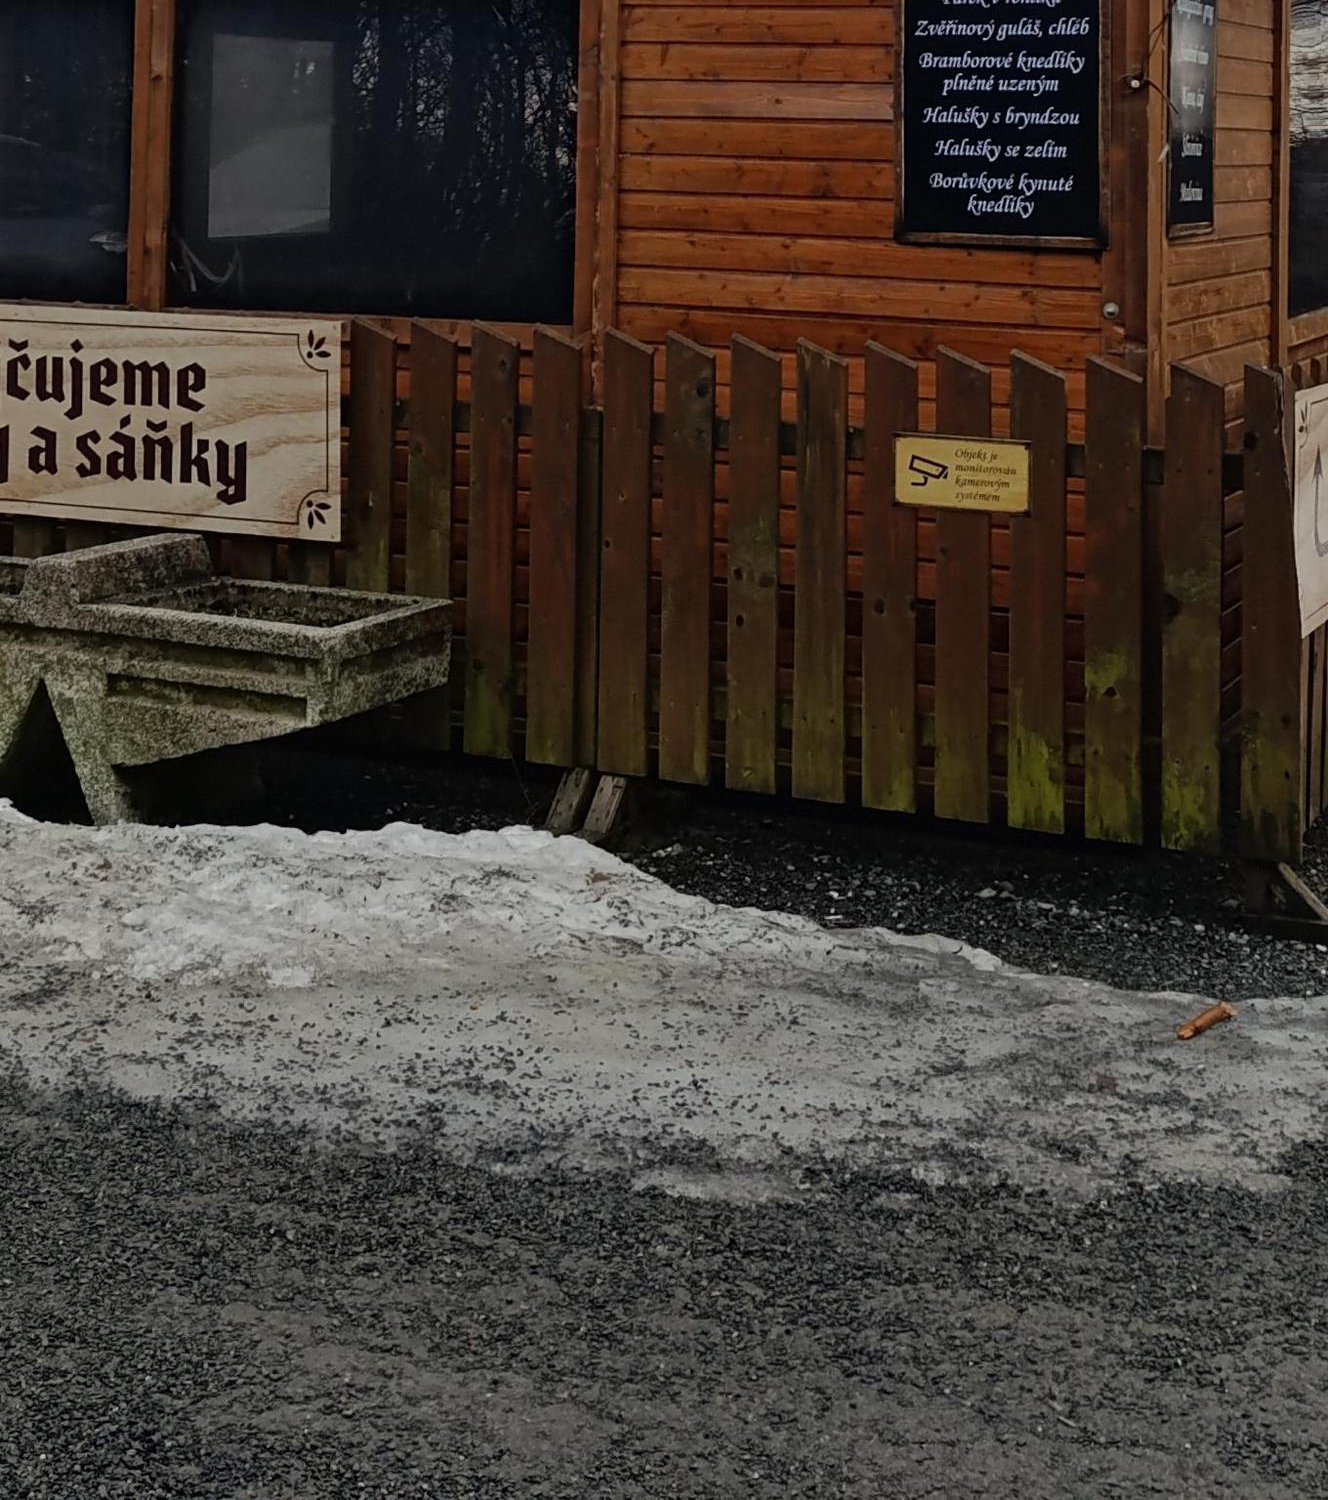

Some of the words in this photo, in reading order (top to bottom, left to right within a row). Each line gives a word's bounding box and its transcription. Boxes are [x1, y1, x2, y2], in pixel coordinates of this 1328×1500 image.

[914, 19, 995, 41] Zvěřinový
[996, 17, 1043, 41] guláš,
[1048, 17, 1090, 36] chléb
[918, 50, 1014, 69] Bramborové
[1016, 50, 1085, 74] knedlíky
[941, 72, 995, 96] plněné
[998, 74, 1059, 97] uzeným
[922, 105, 990, 129] Halušky
[992, 111, 1002, 124] s
[1005, 106, 1081, 130] bryndzou
[934, 138, 1001, 162] Halušky
[1004, 145, 1021, 158] se
[1024, 139, 1068, 159] zelím
[929, 171, 1015, 193] Borůvkové
[1018, 172, 1074, 196] kynuté
[967, 194, 1034, 219] knedlíky
[27, 426, 58, 475] a
[74, 413, 248, 506] sáňky
[954, 448, 987, 462] Objekt
[987, 452, 999, 463] je
[955, 463, 1017, 475] monitorován
[955, 475, 1010, 491] kamerovým
[954, 490, 1000, 502] systémem
